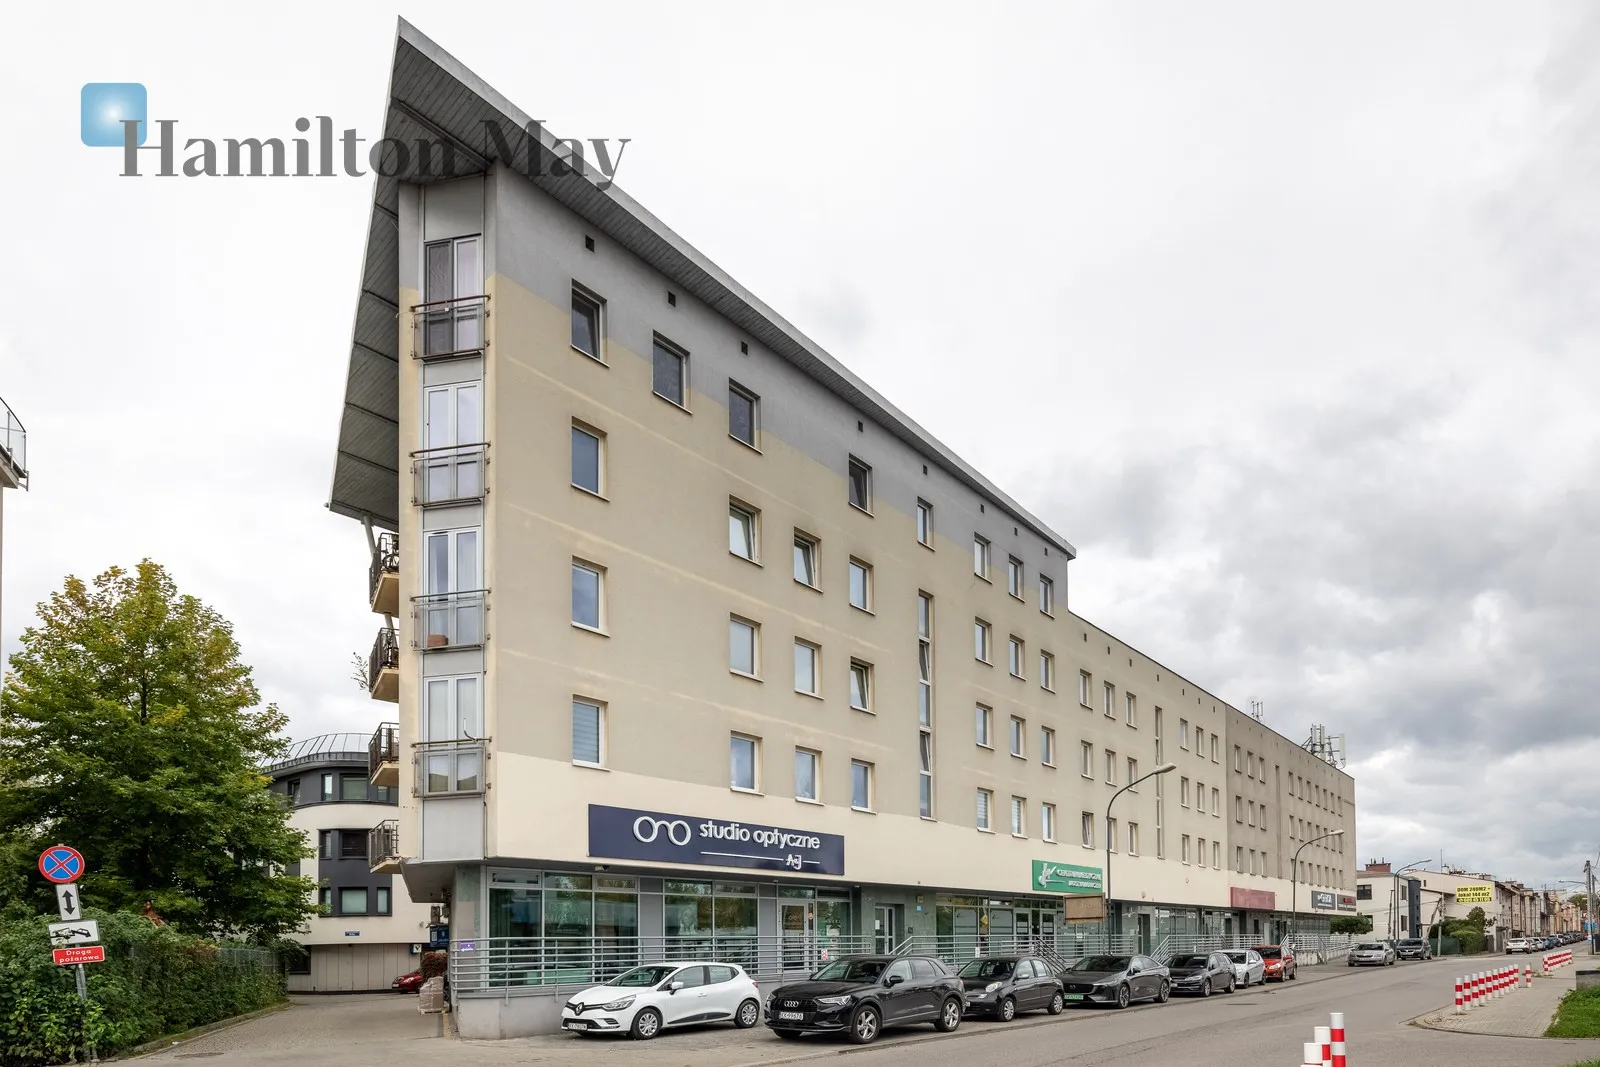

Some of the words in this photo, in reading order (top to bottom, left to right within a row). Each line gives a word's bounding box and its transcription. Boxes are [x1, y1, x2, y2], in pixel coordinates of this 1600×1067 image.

[699, 820, 750, 842] studio
[752, 825, 821, 850] optyczne
[59, 954, 100, 964] pożarowa
